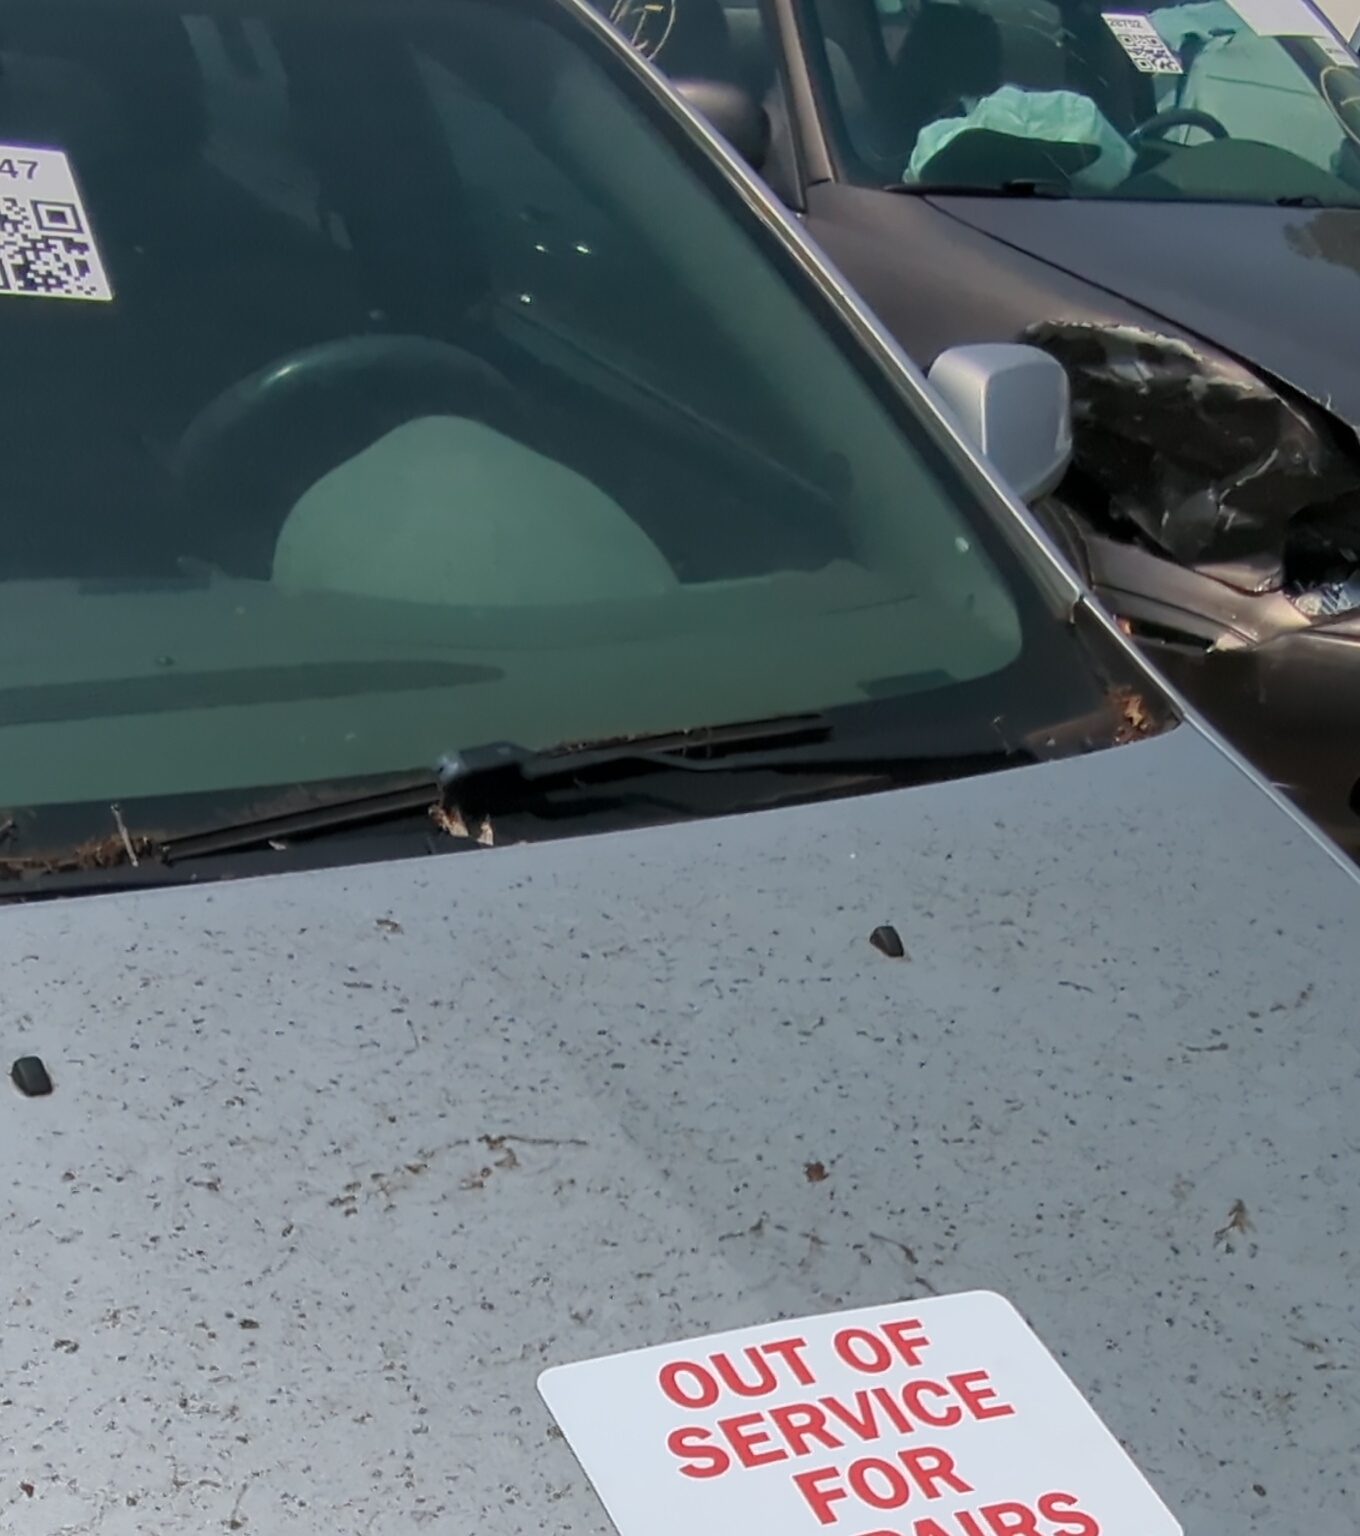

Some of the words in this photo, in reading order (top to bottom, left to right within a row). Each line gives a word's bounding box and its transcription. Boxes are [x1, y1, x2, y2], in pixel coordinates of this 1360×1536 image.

[658, 1336, 817, 1409] OUT
[833, 1318, 930, 1374] OF
[667, 1369, 1015, 1479] SERVICE
[794, 1445, 973, 1525] FOR
